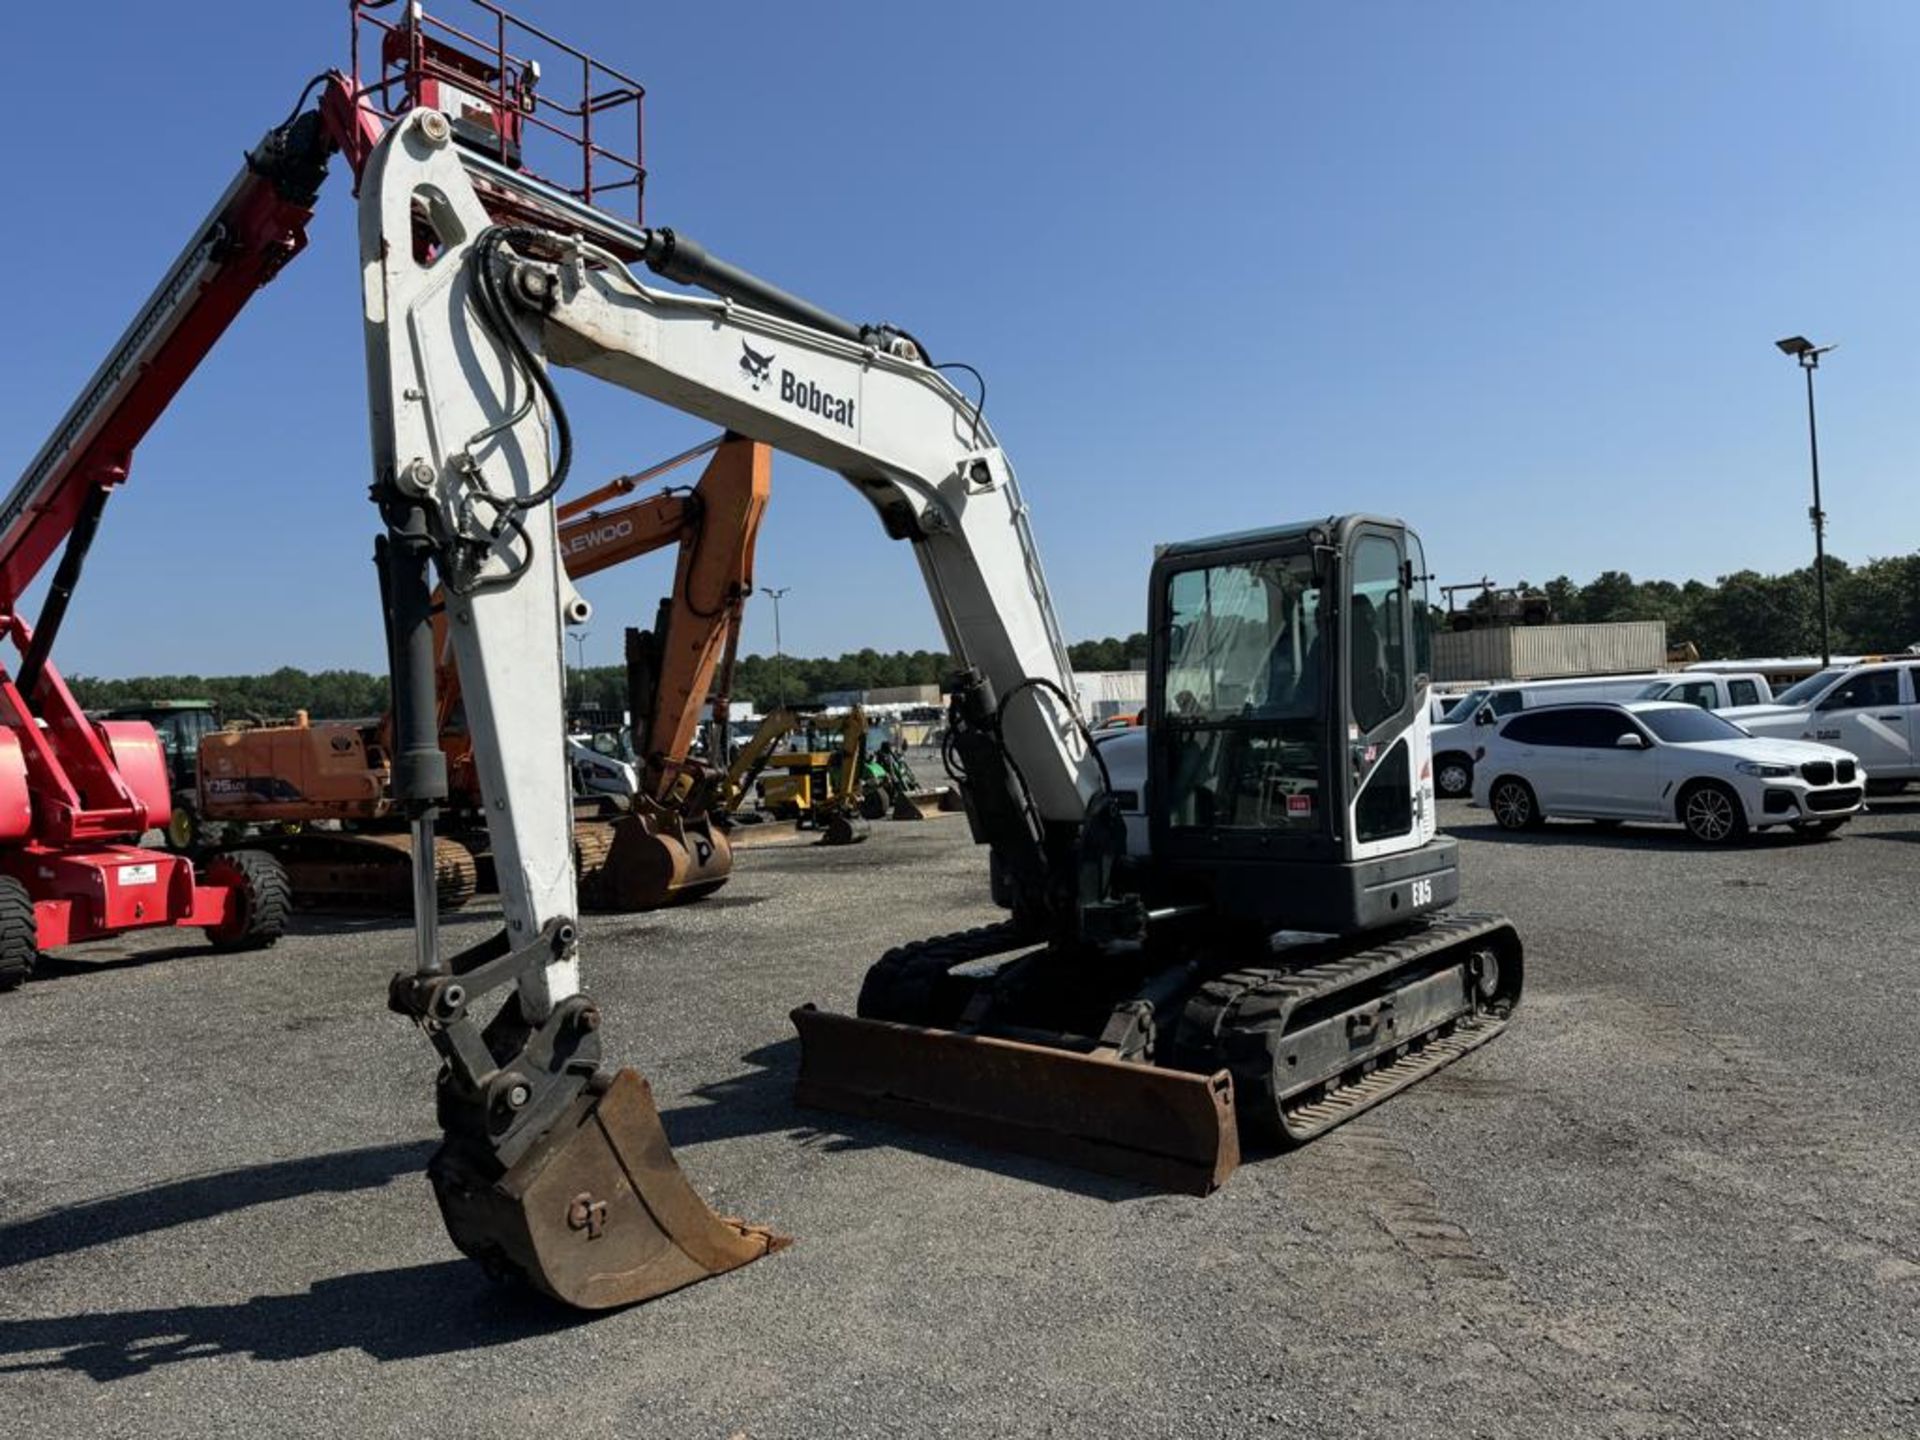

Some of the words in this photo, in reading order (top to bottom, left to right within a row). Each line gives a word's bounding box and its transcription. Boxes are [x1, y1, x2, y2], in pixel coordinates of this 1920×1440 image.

[781, 369, 856, 429] Bobcat
[559, 519, 633, 557] AEWOO
[1412, 879, 1432, 907] E85
